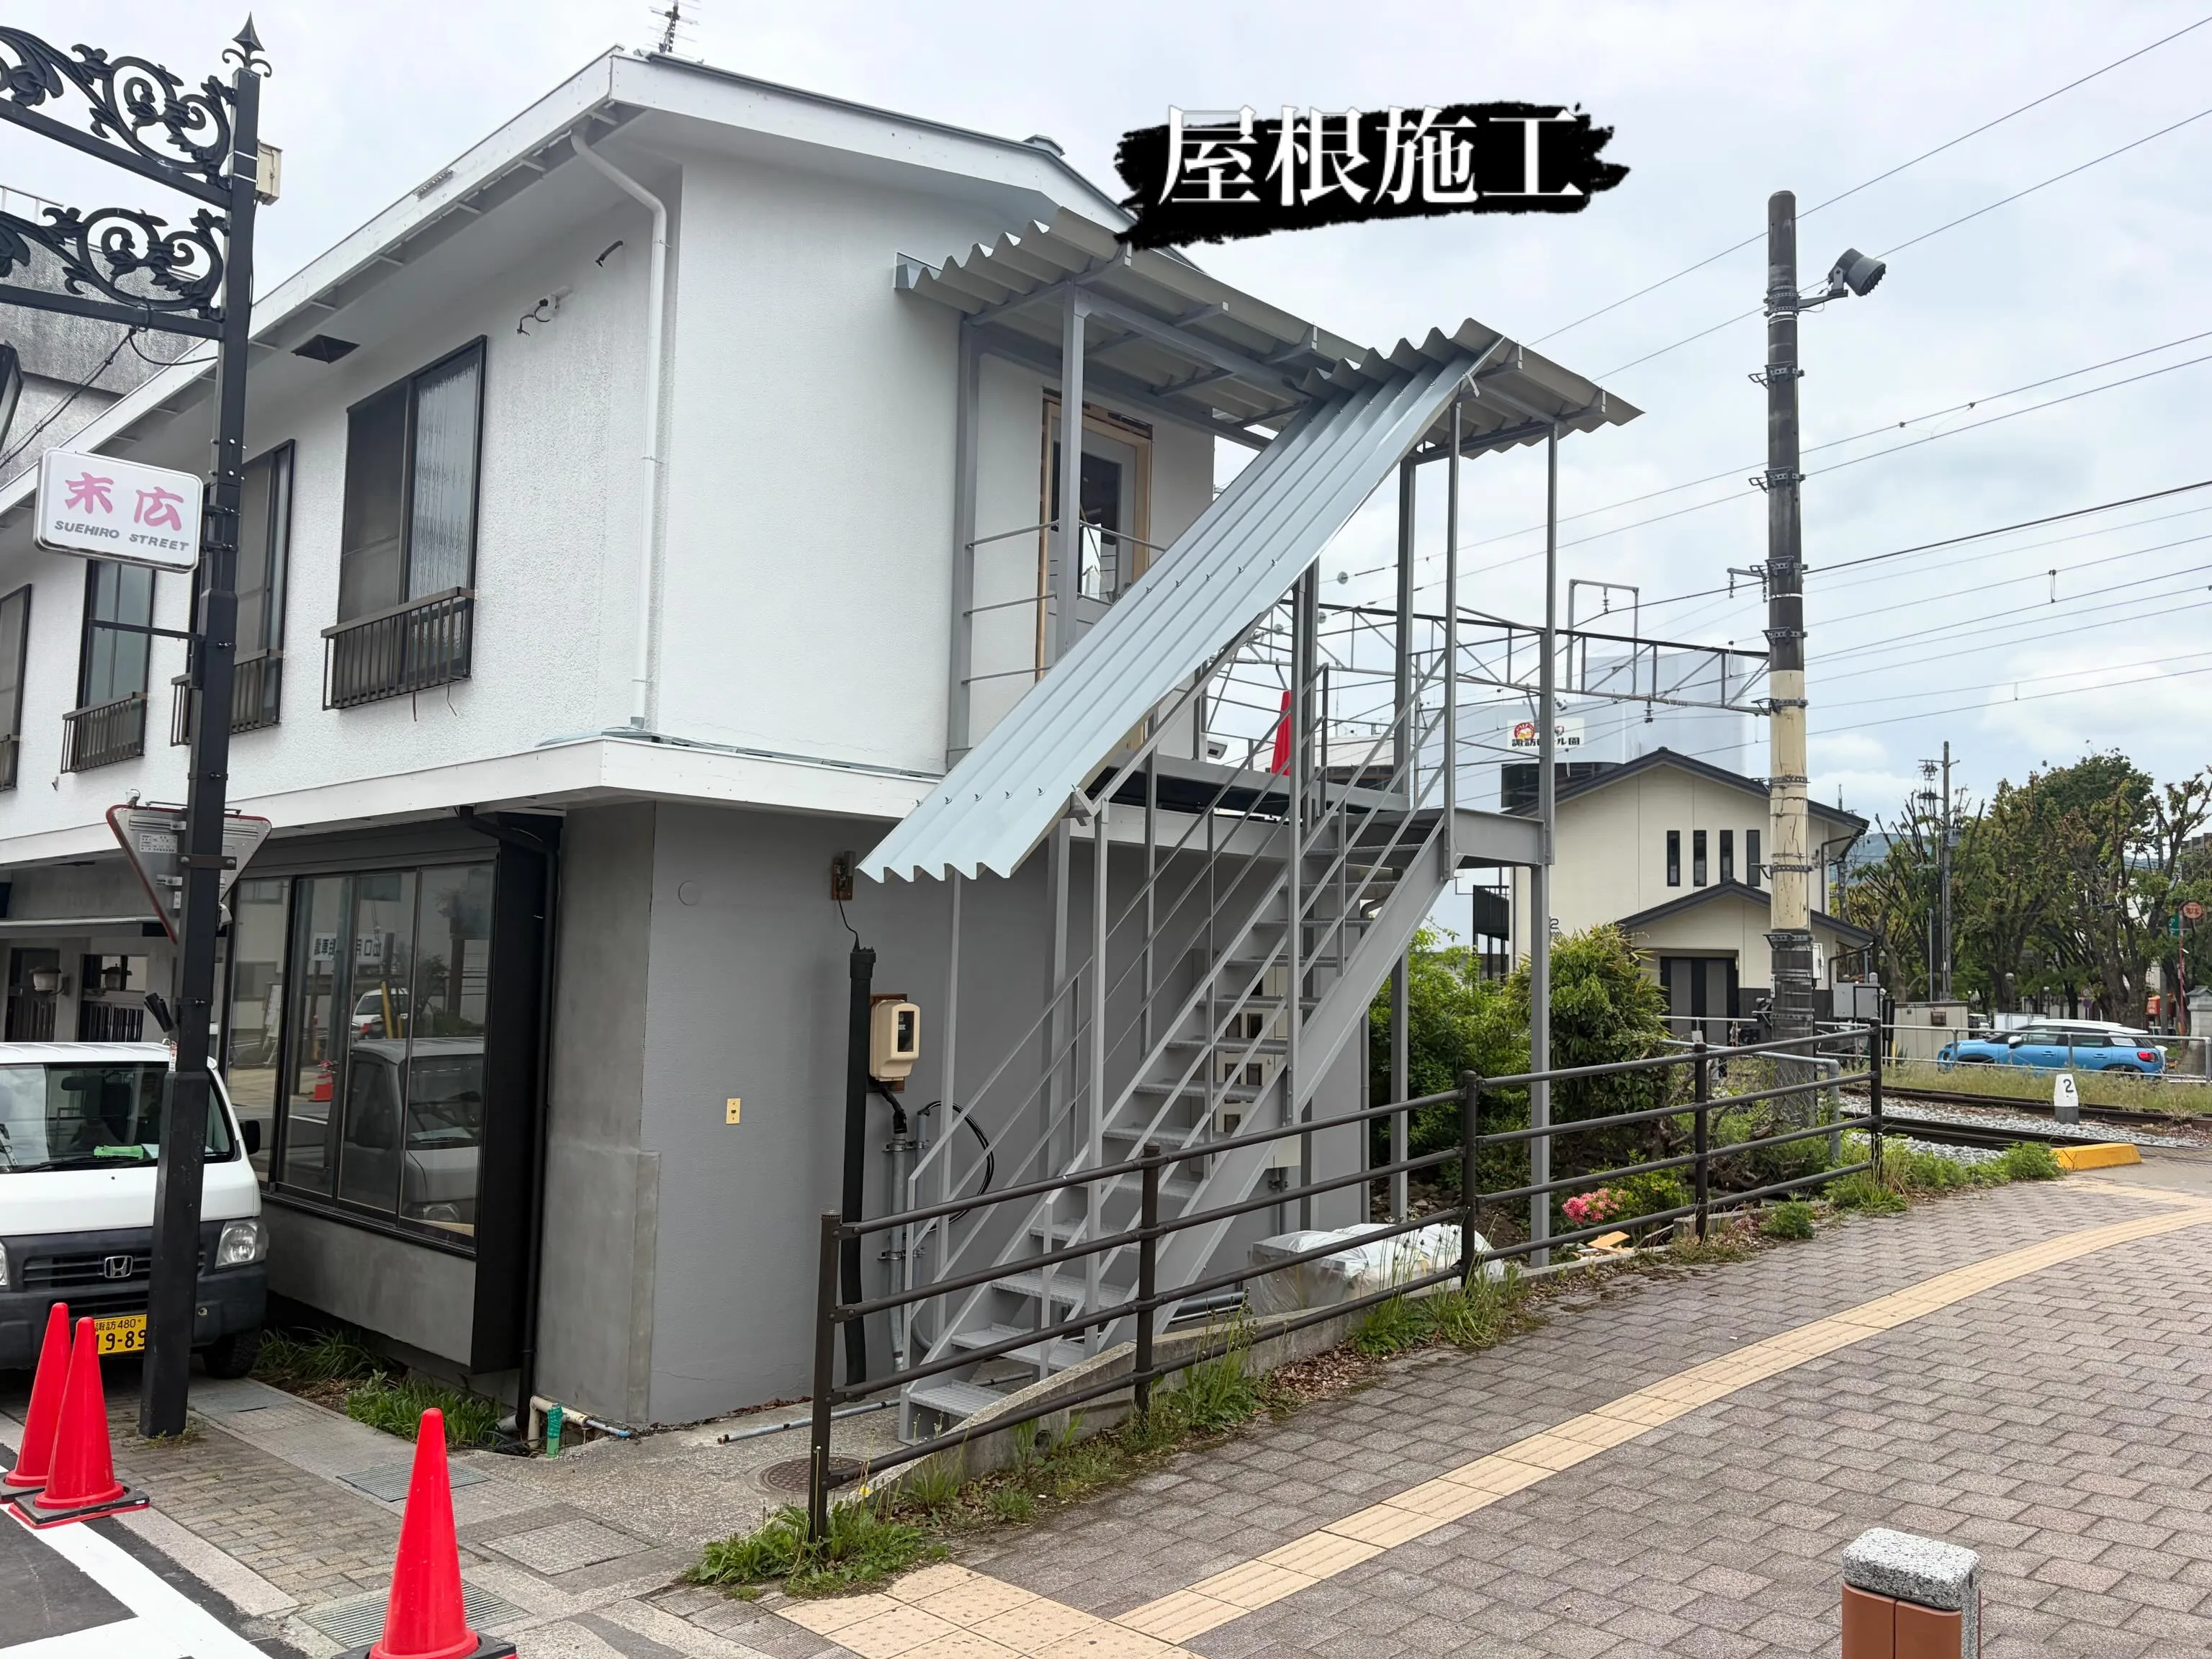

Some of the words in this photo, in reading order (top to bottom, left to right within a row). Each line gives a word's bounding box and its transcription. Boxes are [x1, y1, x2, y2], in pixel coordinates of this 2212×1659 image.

[64, 472, 185, 531] 末広
[54, 520, 120, 539] SUEHIRO
[128, 533, 190, 552] STREET
[1511, 737, 1580, 747] 諏訪ル園
[2062, 1079, 2074, 1093] 2
[94, 1321, 116, 1332] 諏訪
[117, 1318, 136, 1329] 480
